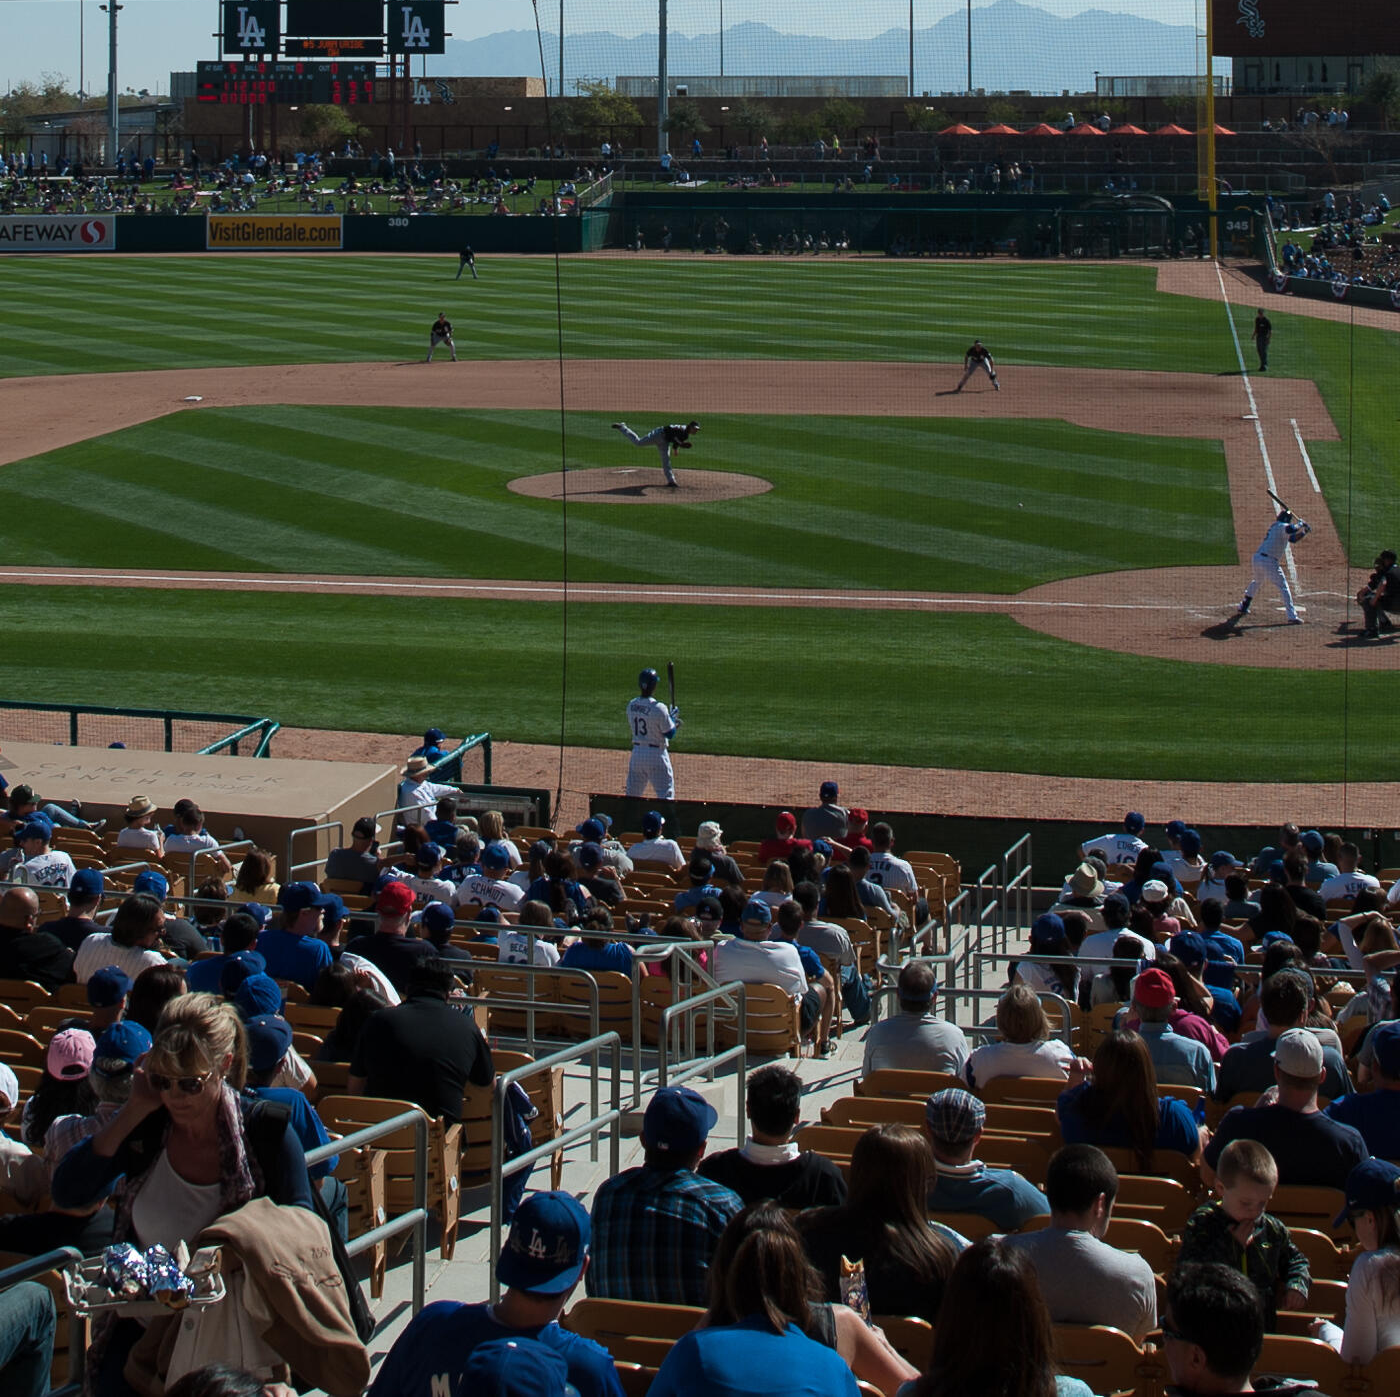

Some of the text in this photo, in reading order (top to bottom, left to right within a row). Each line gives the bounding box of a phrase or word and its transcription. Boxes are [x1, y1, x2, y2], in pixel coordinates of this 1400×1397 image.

[237, 7, 265, 47] LA
[401, 7, 430, 47] LA
[209, 222, 341, 242] VisitGlendale.com
[1225, 220, 1249, 231] 345
[634, 716, 647, 736] 13
[23, 770, 158, 785] RANCH
[39, 762, 285, 784] CAMELBACK
[471, 881, 505, 903] SCHMIDT
[528, 1227, 547, 1259] LA
